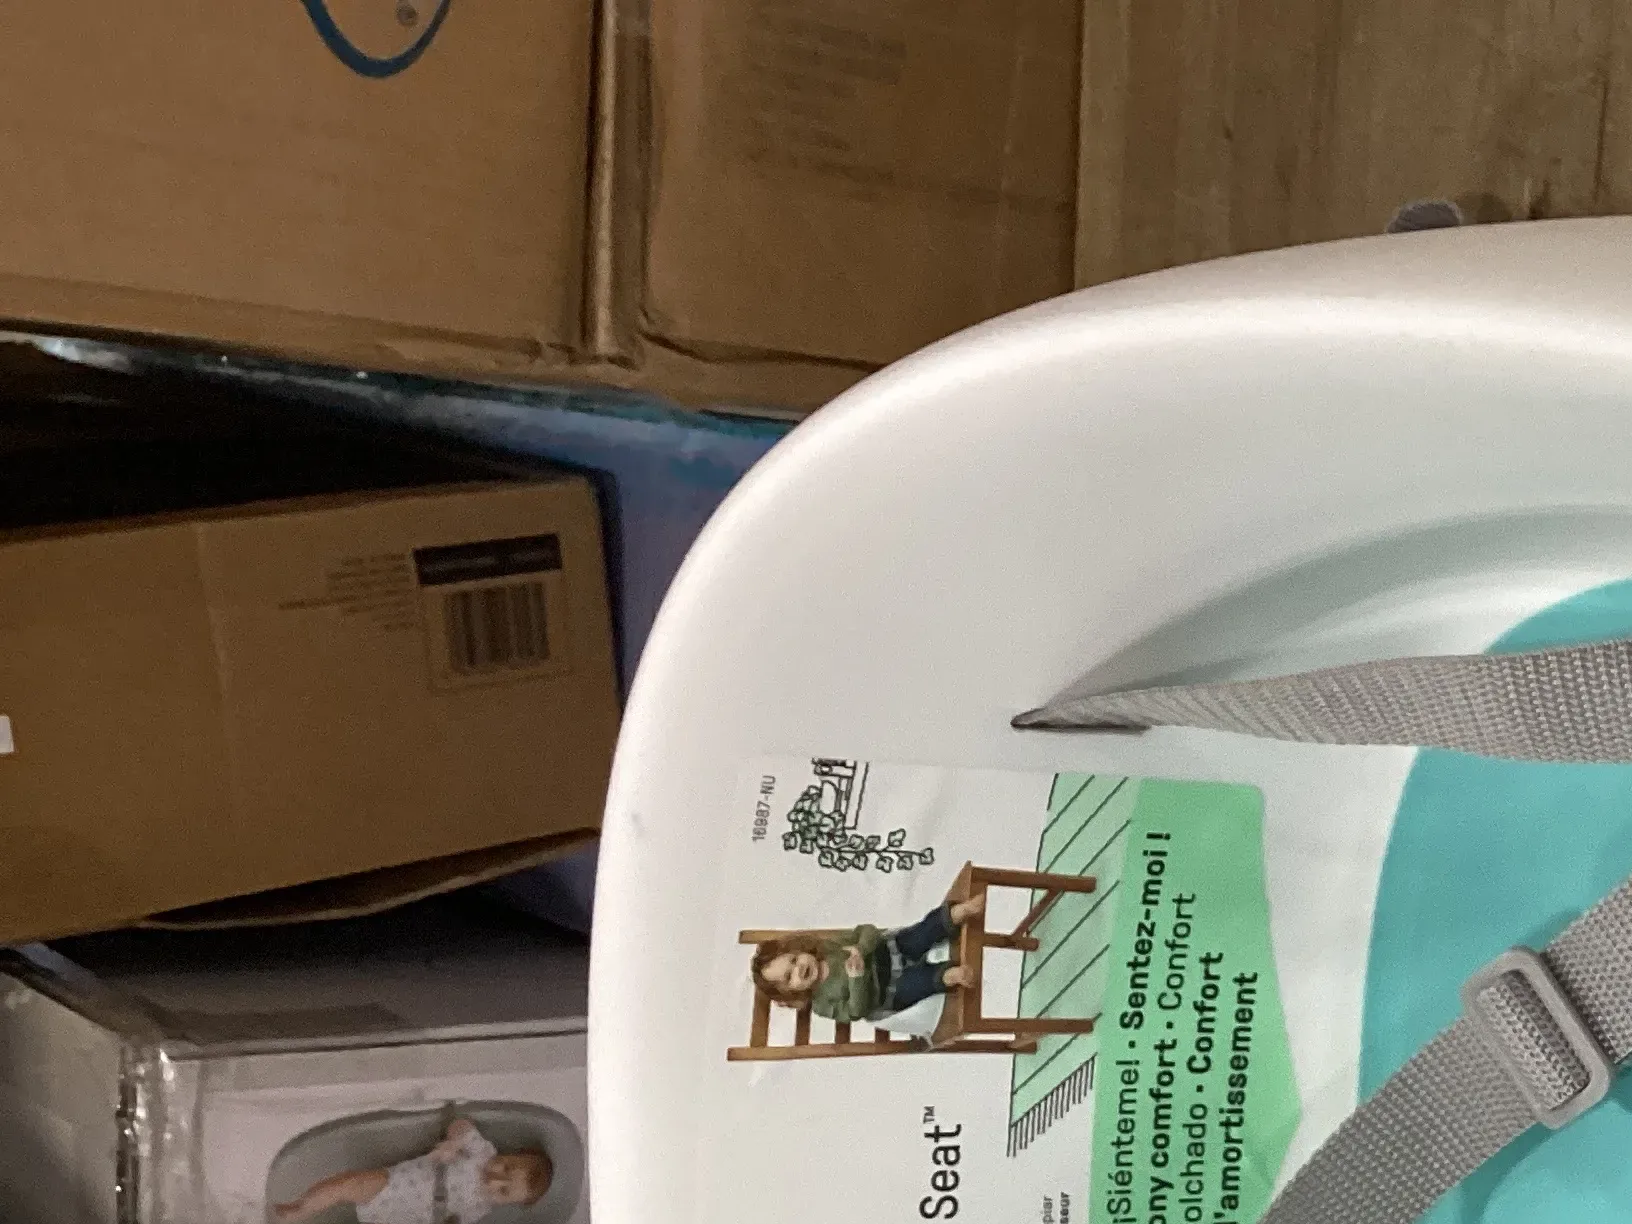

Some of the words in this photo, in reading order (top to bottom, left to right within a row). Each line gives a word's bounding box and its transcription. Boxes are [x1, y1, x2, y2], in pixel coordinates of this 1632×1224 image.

[1119, 848, 1168, 1030] Sentez-moi
[1157, 893, 1195, 1010] Confort
[1188, 951, 1224, 1074] Confort
[1107, 1059, 1141, 1224] ¡Siénteme!
[1147, 1037, 1178, 1168] comfort
